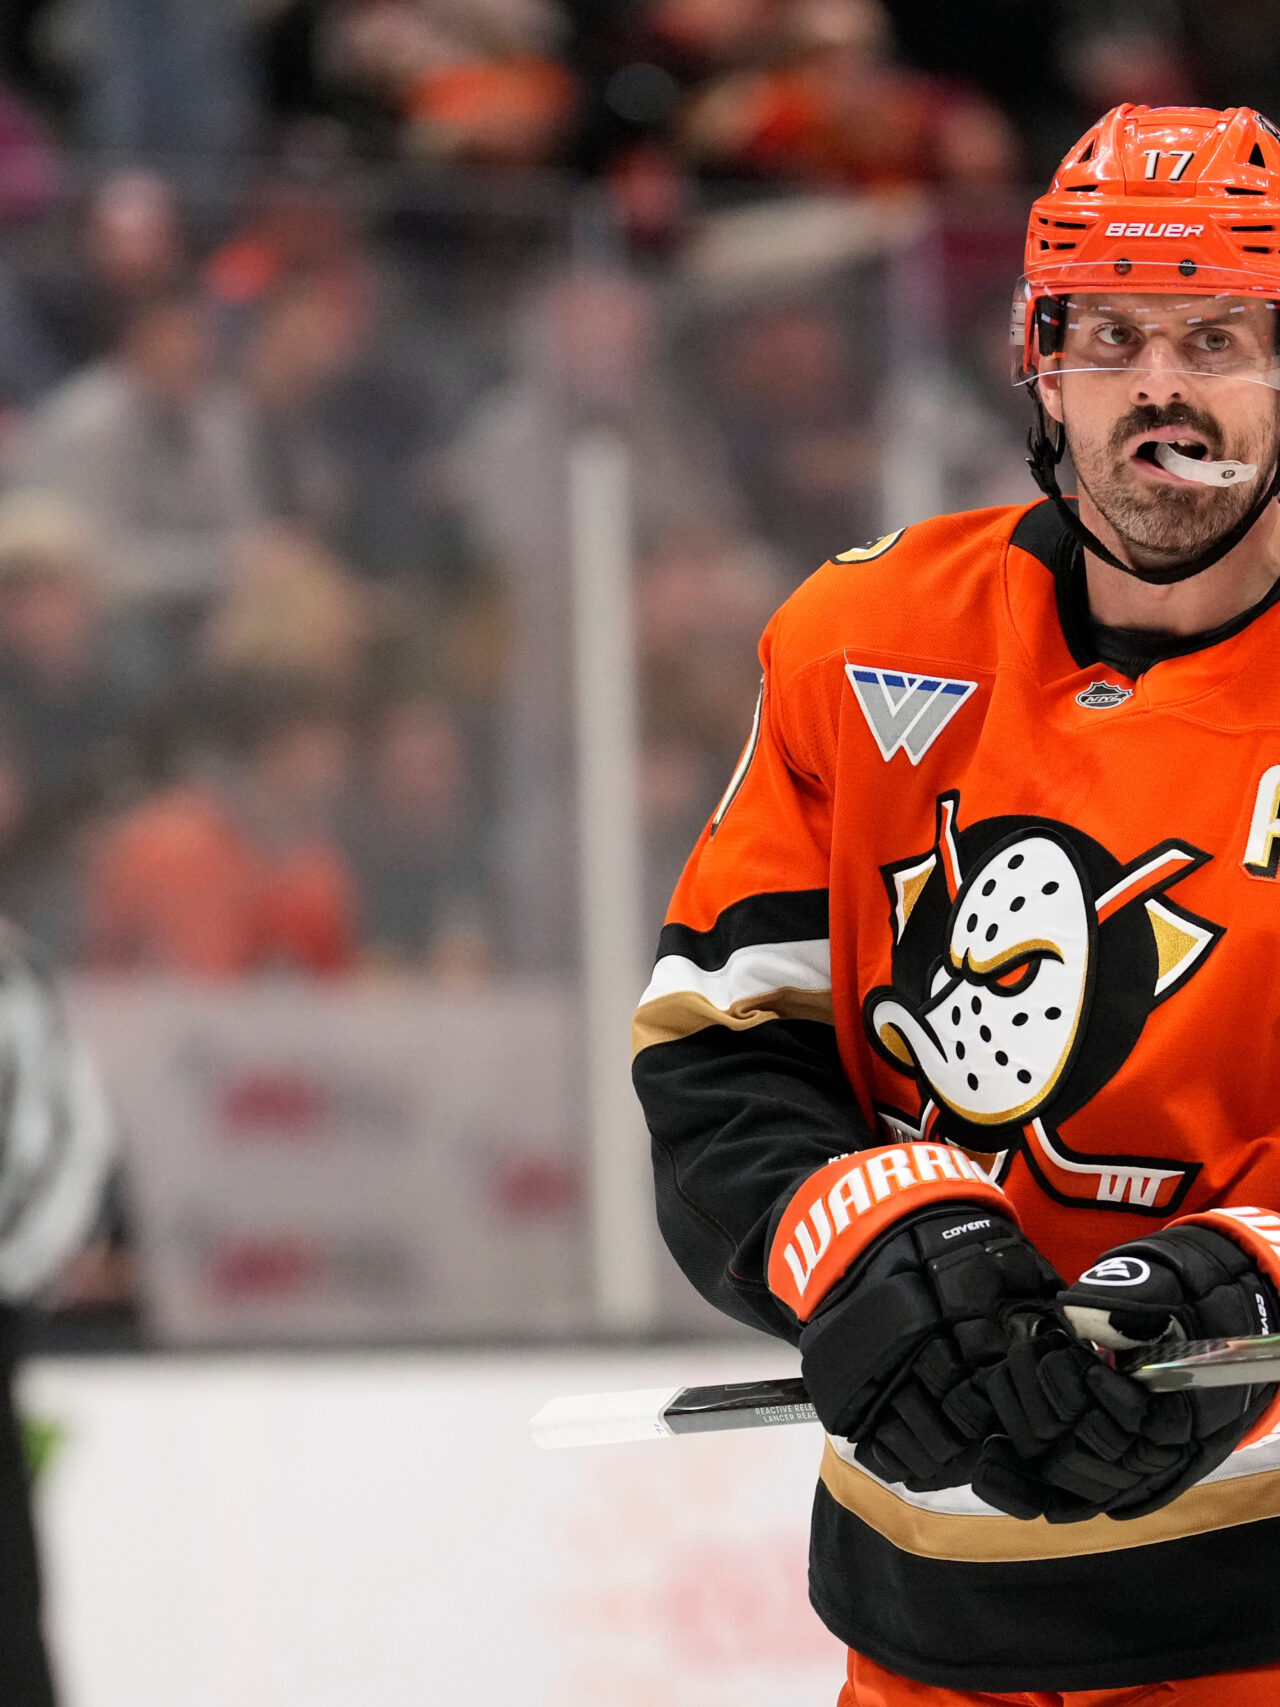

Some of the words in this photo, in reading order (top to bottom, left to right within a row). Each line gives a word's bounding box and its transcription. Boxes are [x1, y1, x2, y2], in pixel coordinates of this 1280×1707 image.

[1143, 149, 1195, 181] 17
[1104, 222, 1204, 238] BAUER
[942, 1219, 991, 1240] COVERT
[755, 1404, 792, 1416] REACTIVE
[794, 1402, 815, 1412] RELE
